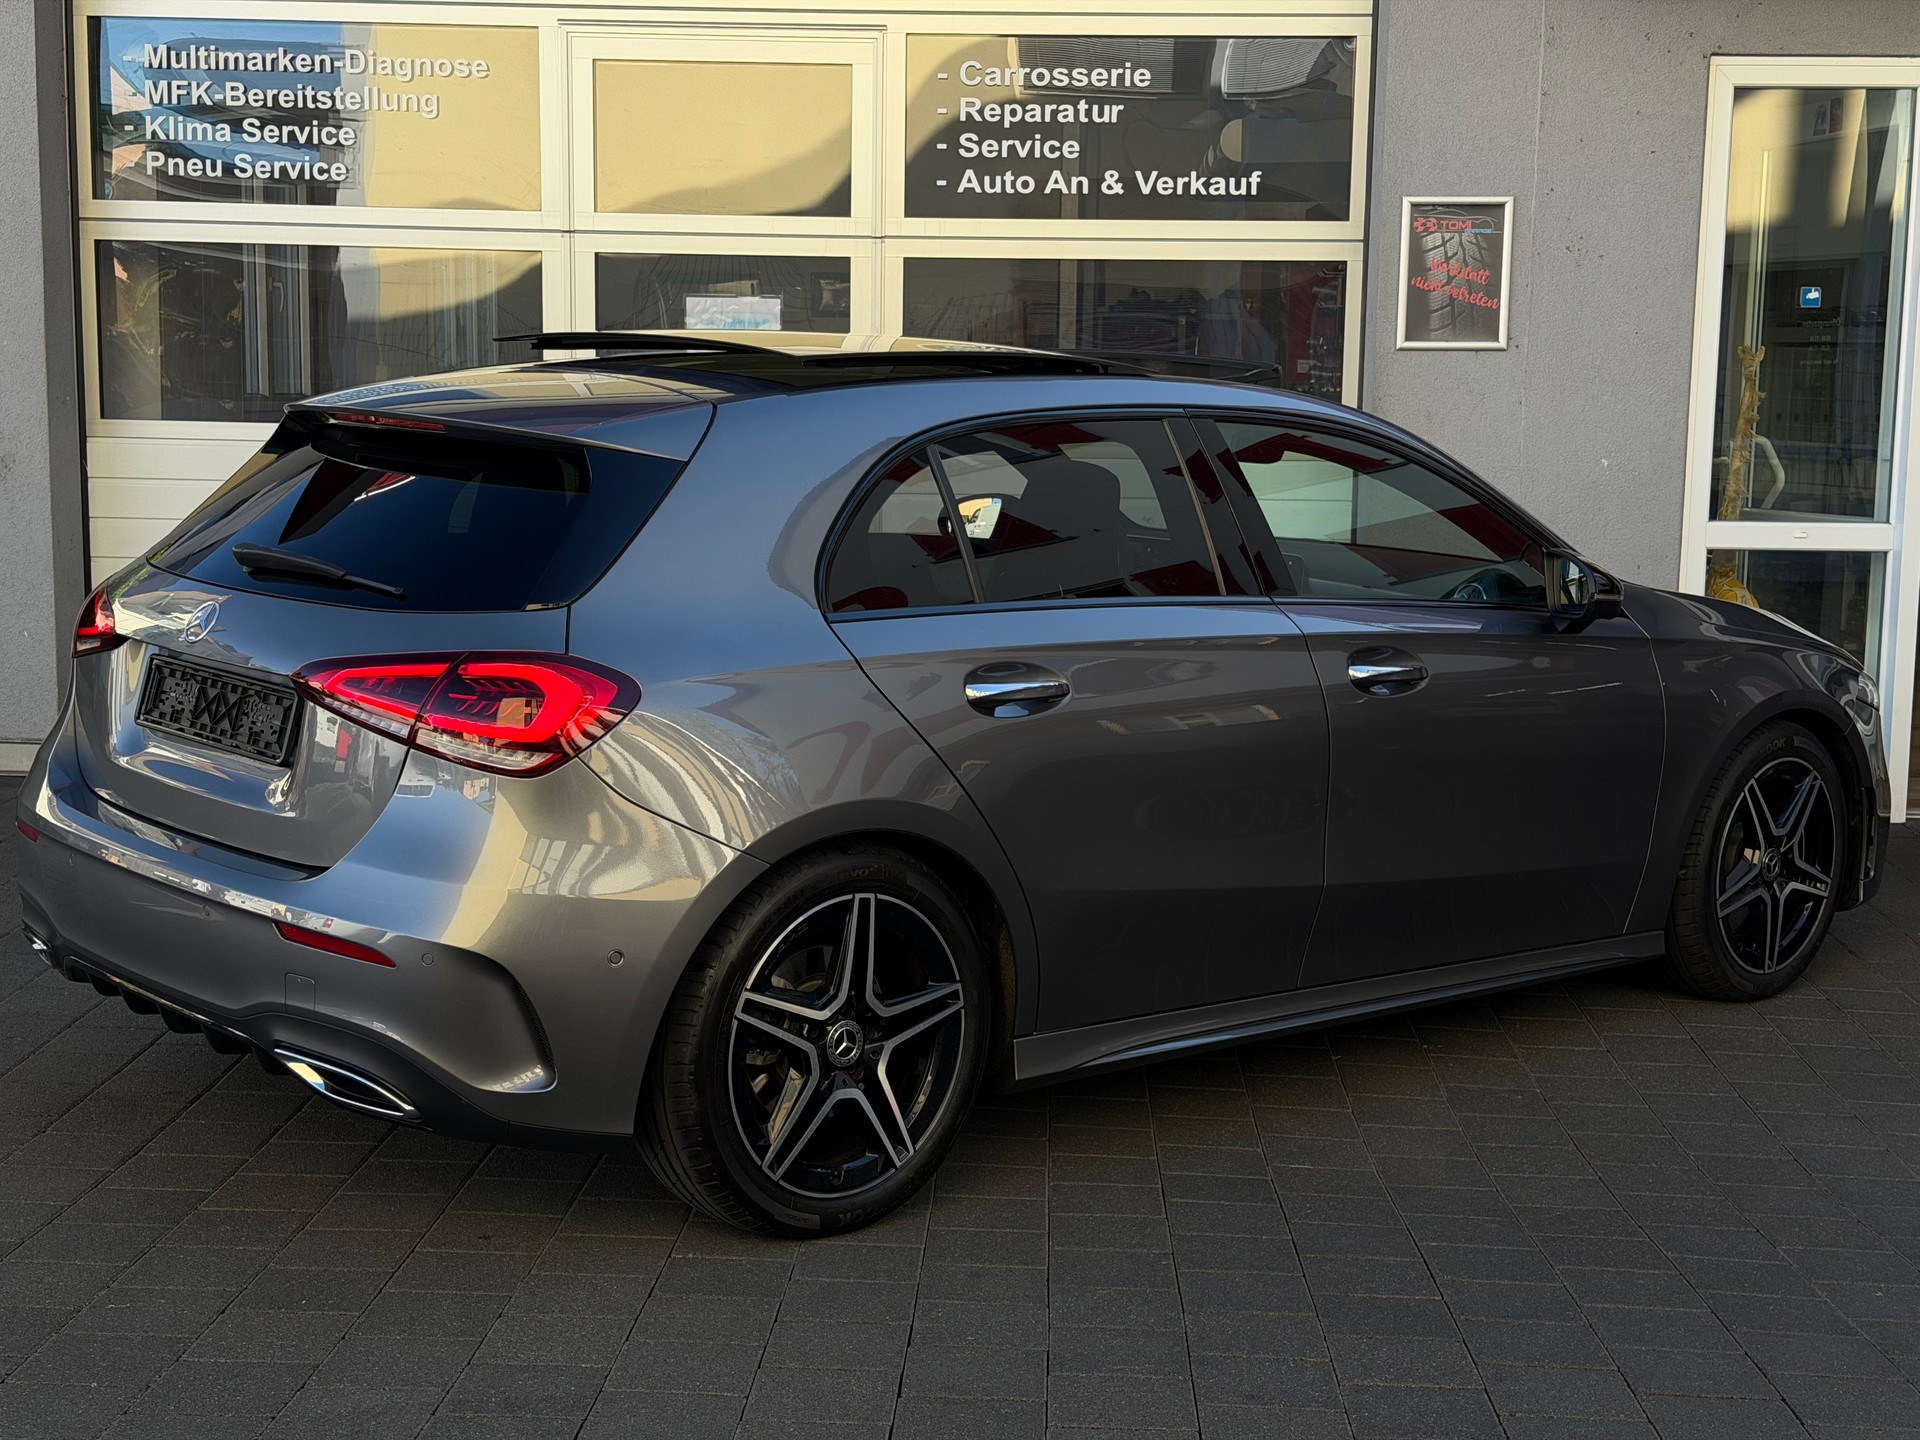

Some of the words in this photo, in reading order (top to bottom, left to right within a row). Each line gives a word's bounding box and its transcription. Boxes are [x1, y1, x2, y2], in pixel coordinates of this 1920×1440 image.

[143, 43, 490, 82] Multimarken-Diagnose
[959, 60, 1152, 88] Carrosserie
[144, 79, 440, 119] MFK-Bereitstellung
[959, 97, 1125, 128] Reparatur
[145, 115, 231, 142] Klima
[241, 117, 357, 146] Service
[958, 132, 1080, 159] Service
[146, 151, 223, 178] Pneu
[233, 153, 348, 181] Service
[956, 168, 1036, 194] Auto
[1043, 169, 1089, 195] An
[1100, 169, 1125, 195] &
[1134, 170, 1263, 196] Verkauf
[1446, 282, 1499, 309] betreten
